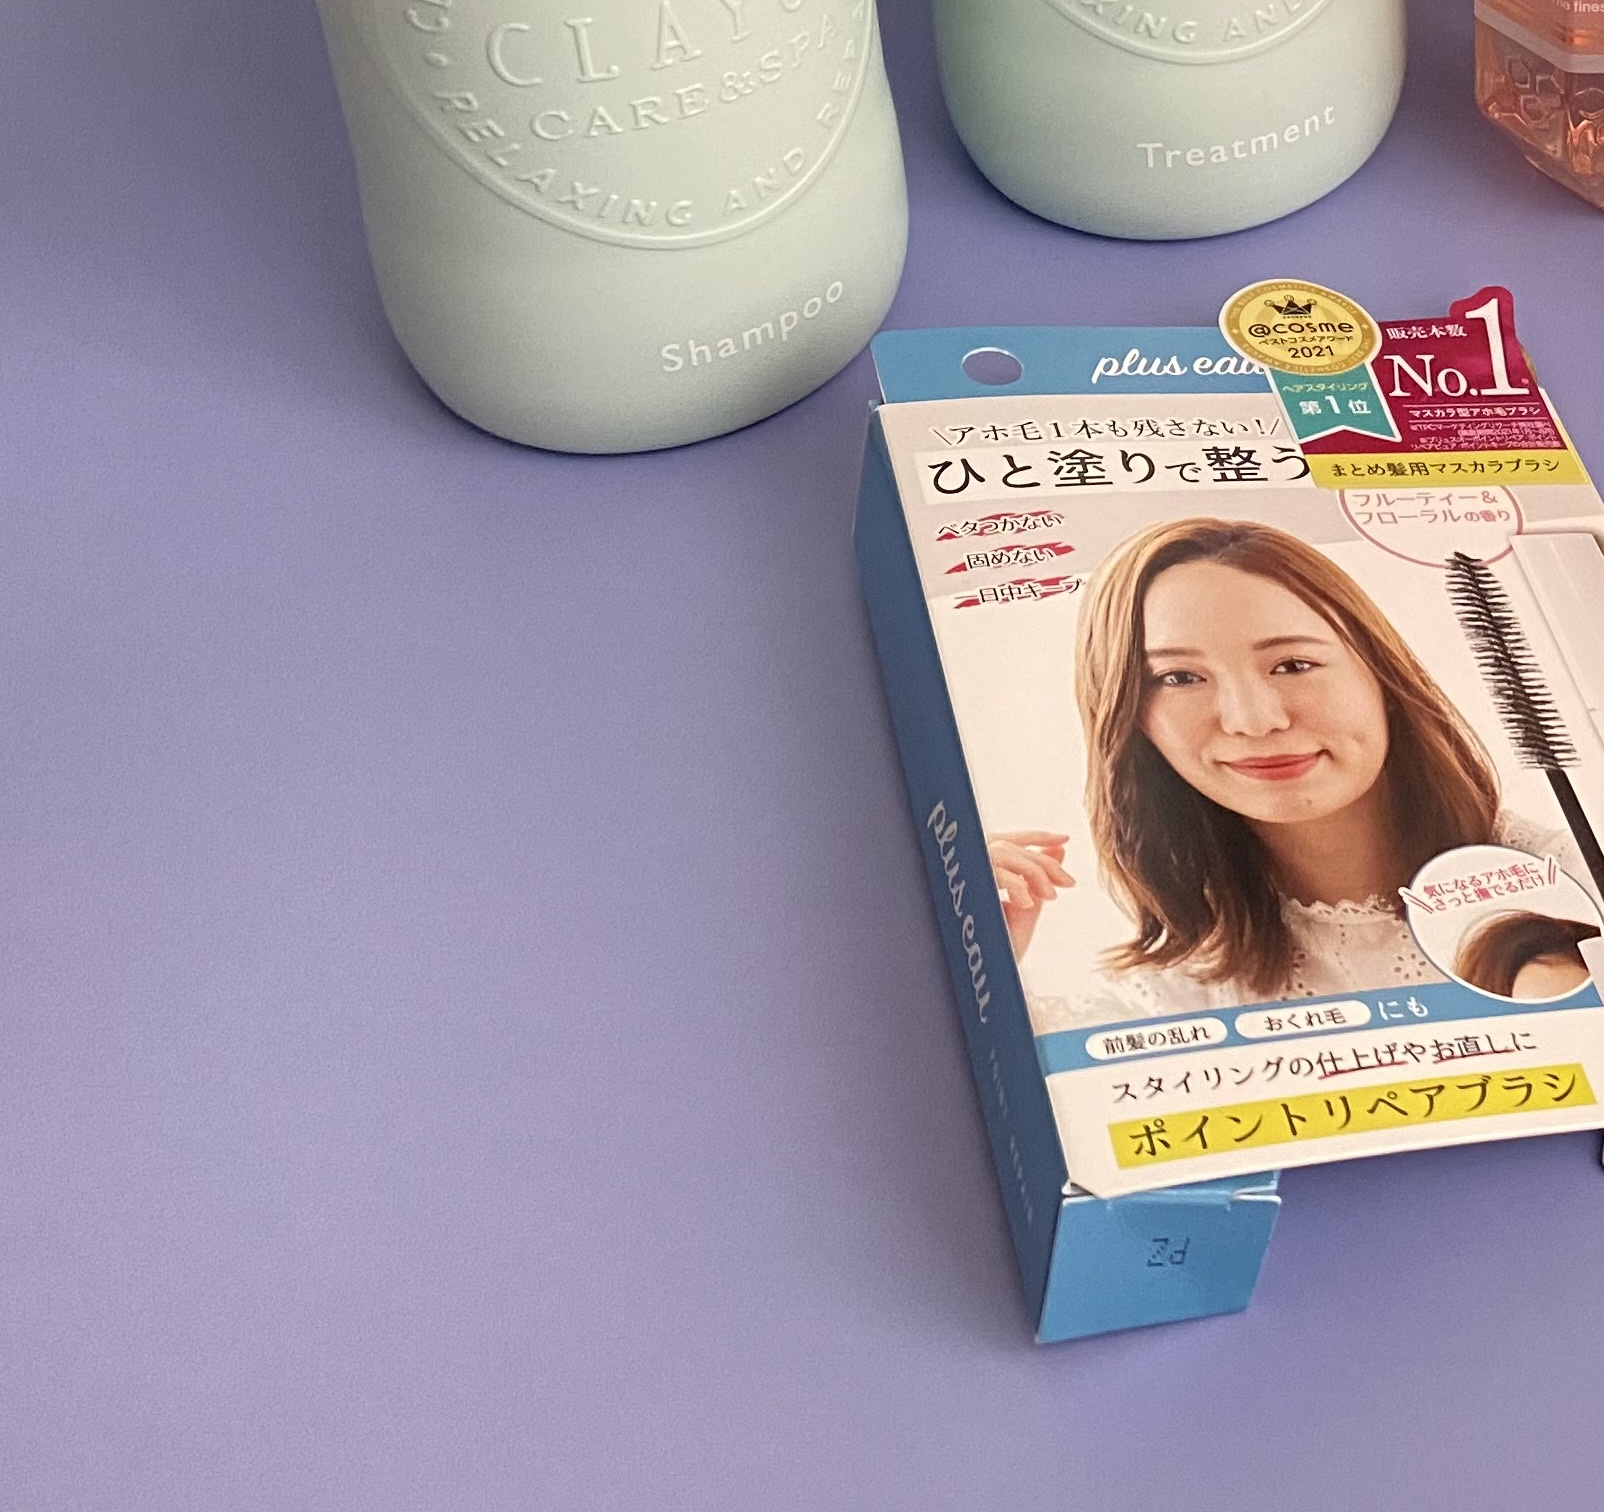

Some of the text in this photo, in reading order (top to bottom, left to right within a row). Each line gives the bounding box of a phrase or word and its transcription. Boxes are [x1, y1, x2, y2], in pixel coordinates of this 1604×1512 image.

[1137, 104, 1337, 169] Treatment
[433, 88, 807, 228] RELAXING AND
[660, 279, 844, 373] Shampoo
[1248, 320, 1354, 339] @cosme
[1258, 334, 1354, 347] ベストコスメアワード
[1091, 345, 1188, 385] plus
[1287, 344, 1336, 360] 2021
[1383, 297, 1531, 397] No.1
[1299, 396, 1372, 415] 第1位
[928, 447, 1312, 496] ひと塗りで整う
[1330, 457, 1561, 479] まとめ髪用マスカラブラシ
[1353, 490, 1499, 507] フルーティー&
[1353, 509, 1511, 525] フローラルの香り
[937, 508, 1064, 539] ベタつかない
[966, 546, 1056, 571] 固めない
[953, 576, 1088, 607] 一日中キープ
[1423, 860, 1540, 900] 気になるアホ毛に
[1433, 873, 1546, 913] さっと撫でるだけ
[1102, 996, 1430, 1058] 前髪の乱れ おくれ毛 にも
[1111, 1028, 1539, 1105] スタイリングの仕上げやお直しに
[1131, 1074, 1582, 1159] ポイントリペアブラシ
